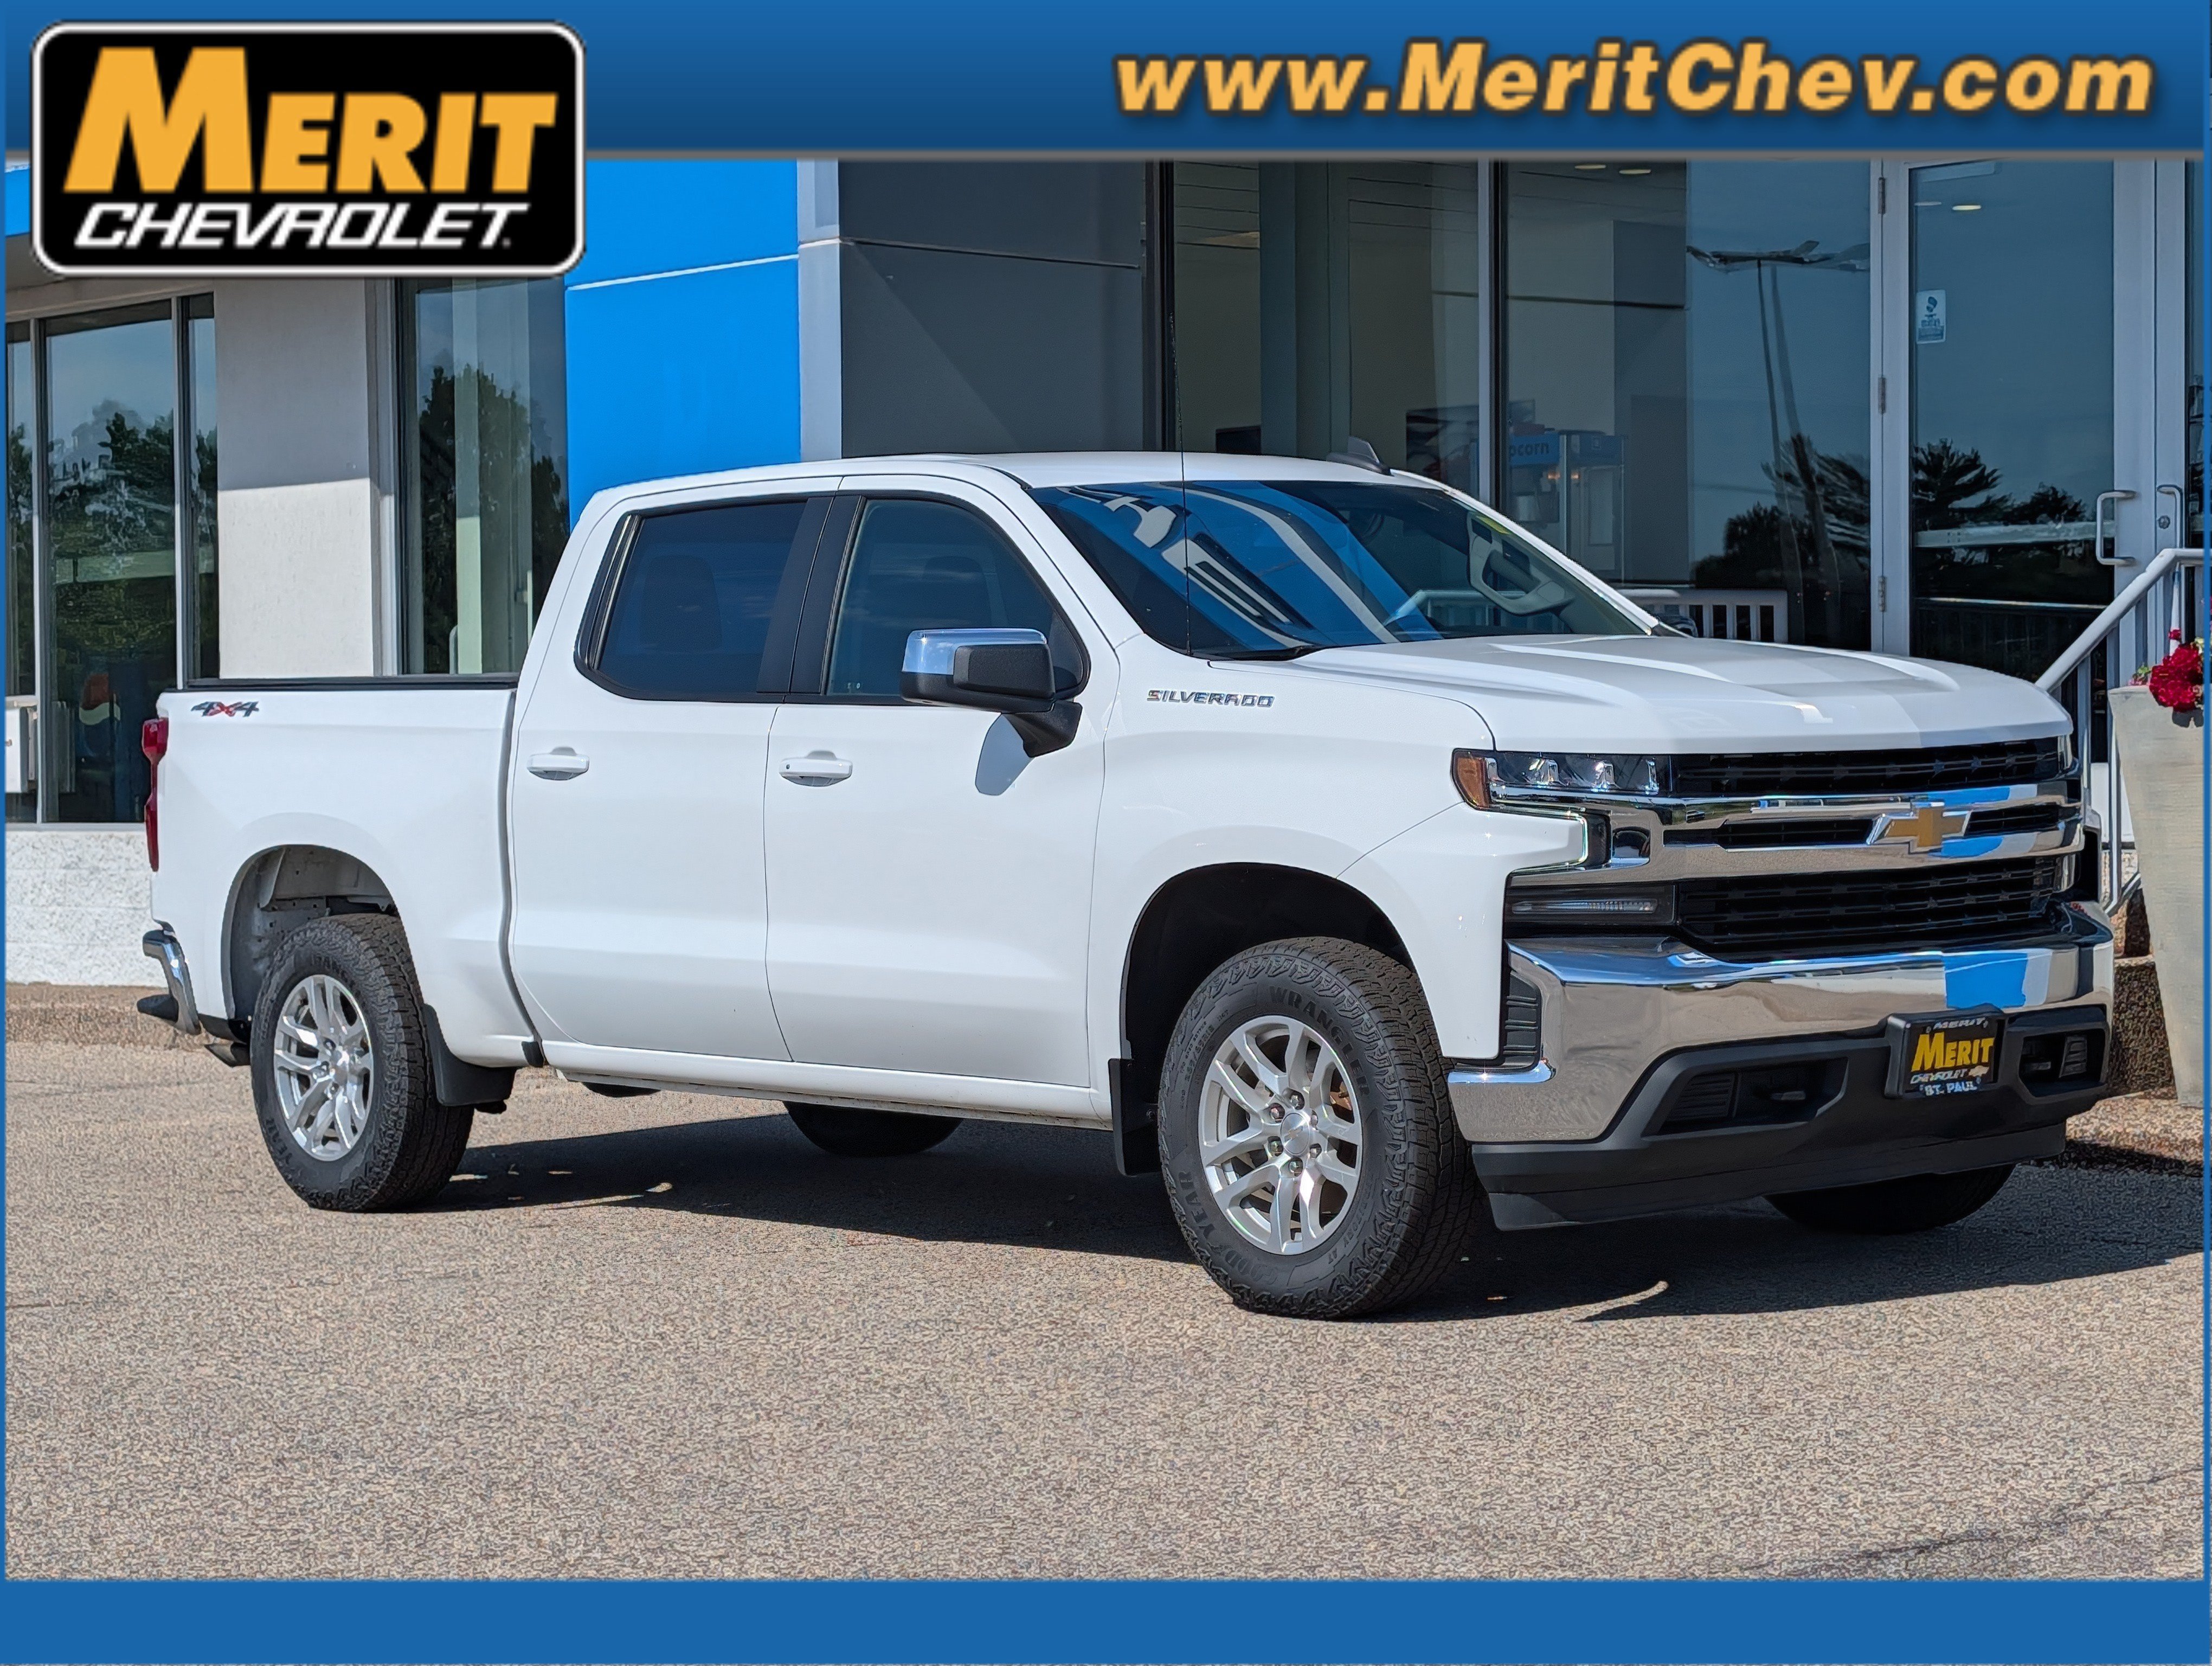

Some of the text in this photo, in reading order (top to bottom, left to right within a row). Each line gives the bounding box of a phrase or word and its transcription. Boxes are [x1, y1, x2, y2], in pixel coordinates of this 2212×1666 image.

[1146, 689, 1275, 708] SILVERADO
[1269, 985, 1371, 1096] WRANGLER
[1911, 1031, 1995, 1073] MERIT
[1946, 1081, 1977, 1093] PAUL
